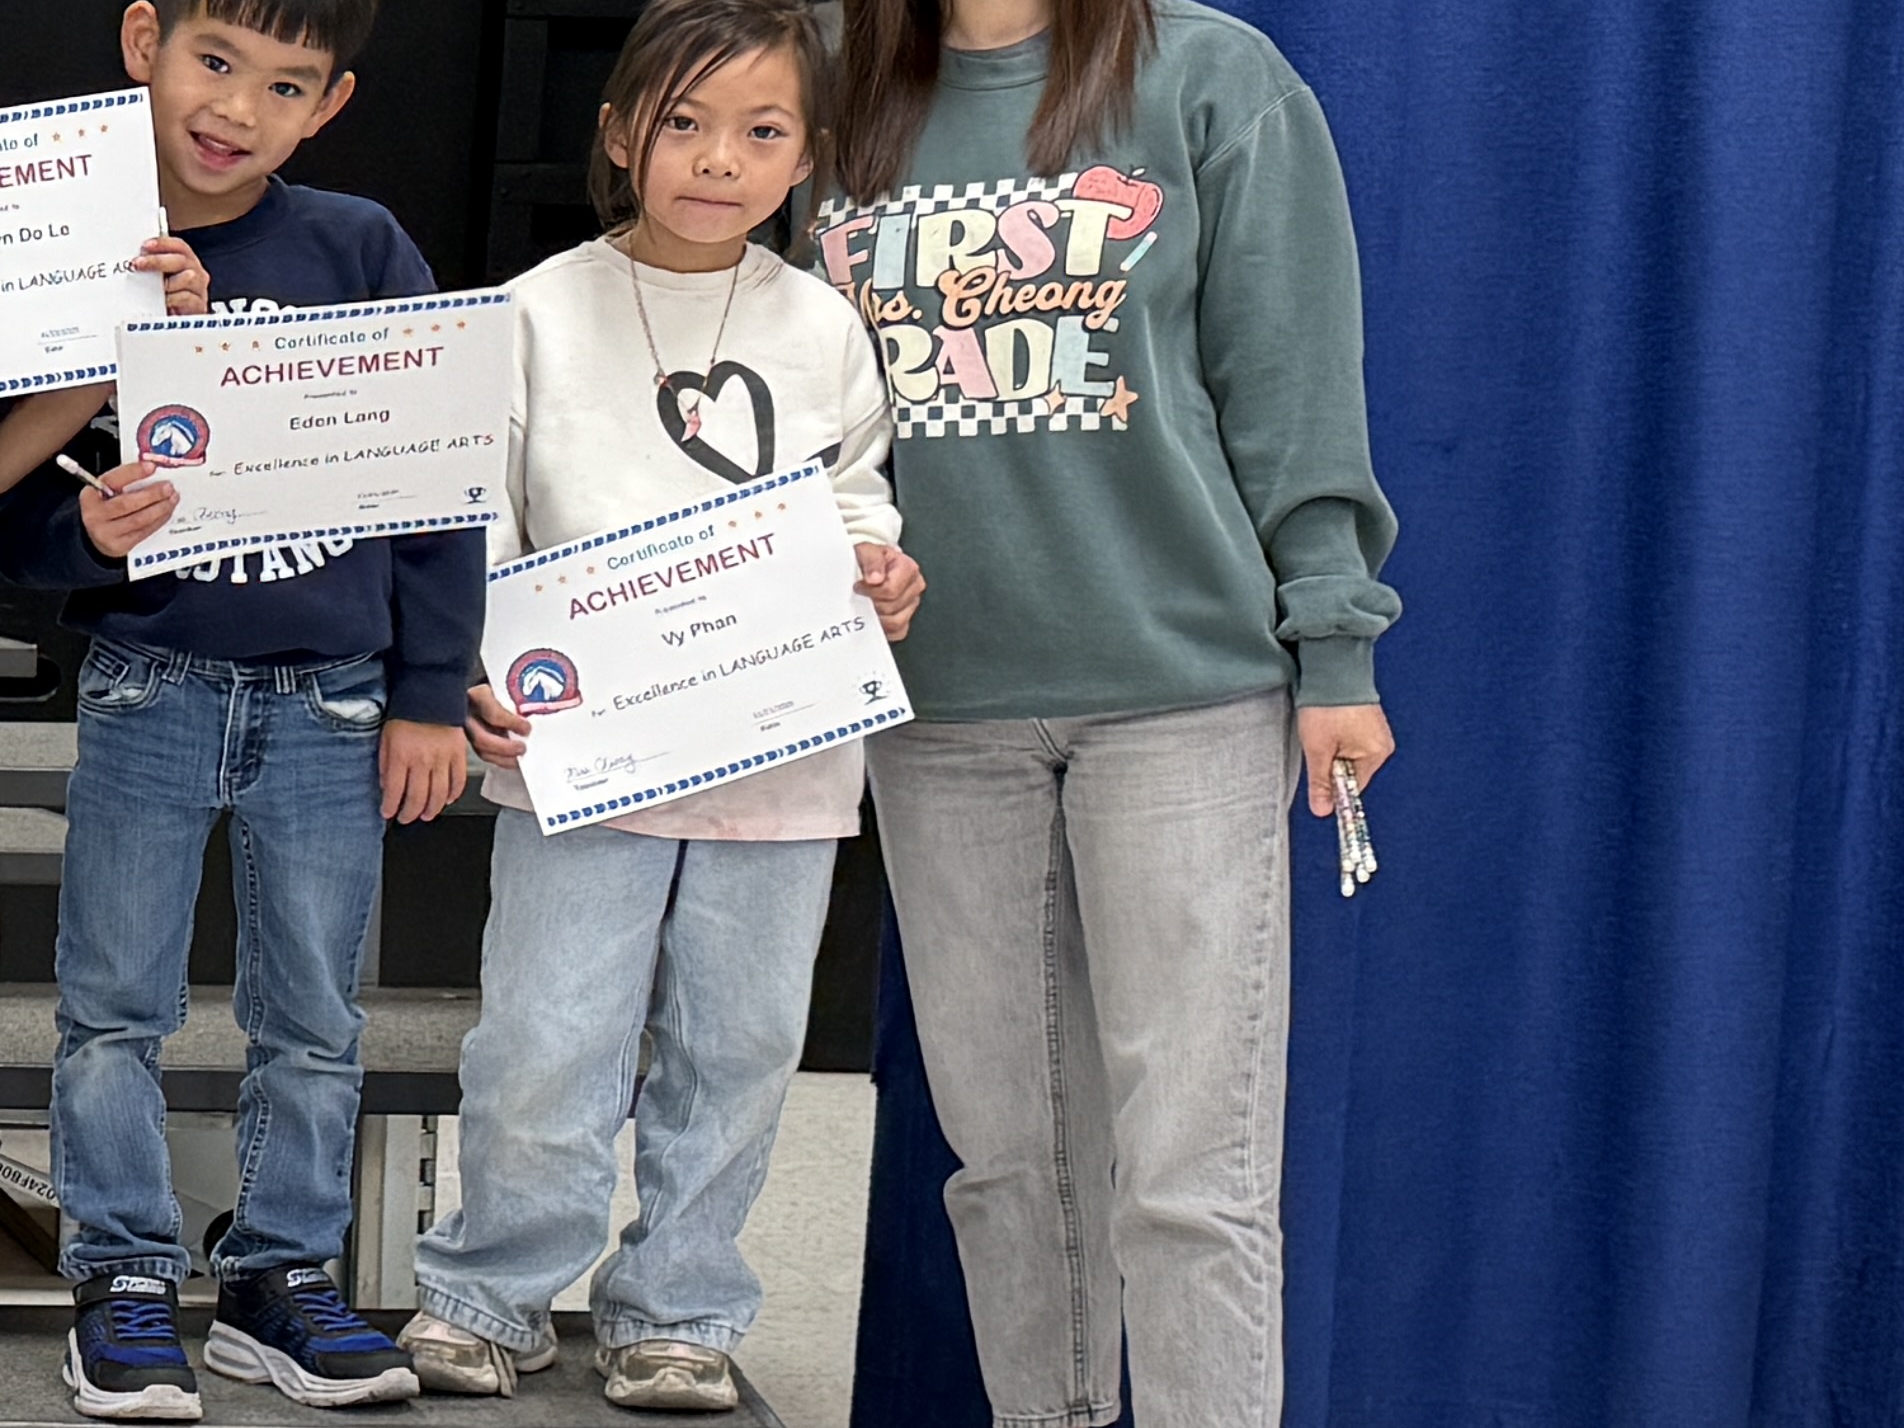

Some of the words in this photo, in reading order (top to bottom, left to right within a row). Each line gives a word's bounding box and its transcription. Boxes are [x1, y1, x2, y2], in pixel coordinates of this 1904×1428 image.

[24, 133, 38, 148] of
[19, 228, 42, 242] Do
[820, 200, 1133, 288] FIRST
[1, 282, 14, 292] in
[19, 262, 107, 290] LANGUAGE
[113, 258, 137, 274] AR
[937, 267, 1127, 329] Cheong
[275, 331, 366, 350] Certificate
[372, 327, 389, 341] of
[882, 315, 1120, 402] RADE
[221, 346, 444, 387] ACHIEVEMENT
[325, 454, 339, 464] in
[344, 438, 440, 462] LANGUAGE
[447, 434, 494, 449] ARTS
[607, 535, 694, 570] Certificate
[699, 525, 714, 540] of
[570, 533, 774, 620] ACHIEVEMENT
[661, 631, 684, 646] Vy
[690, 615, 737, 637] Phan
[613, 676, 698, 710] Excellence
[702, 670, 716, 681] in
[719, 633, 814, 676] LANGUAGE
[821, 616, 865, 642] ARTS
